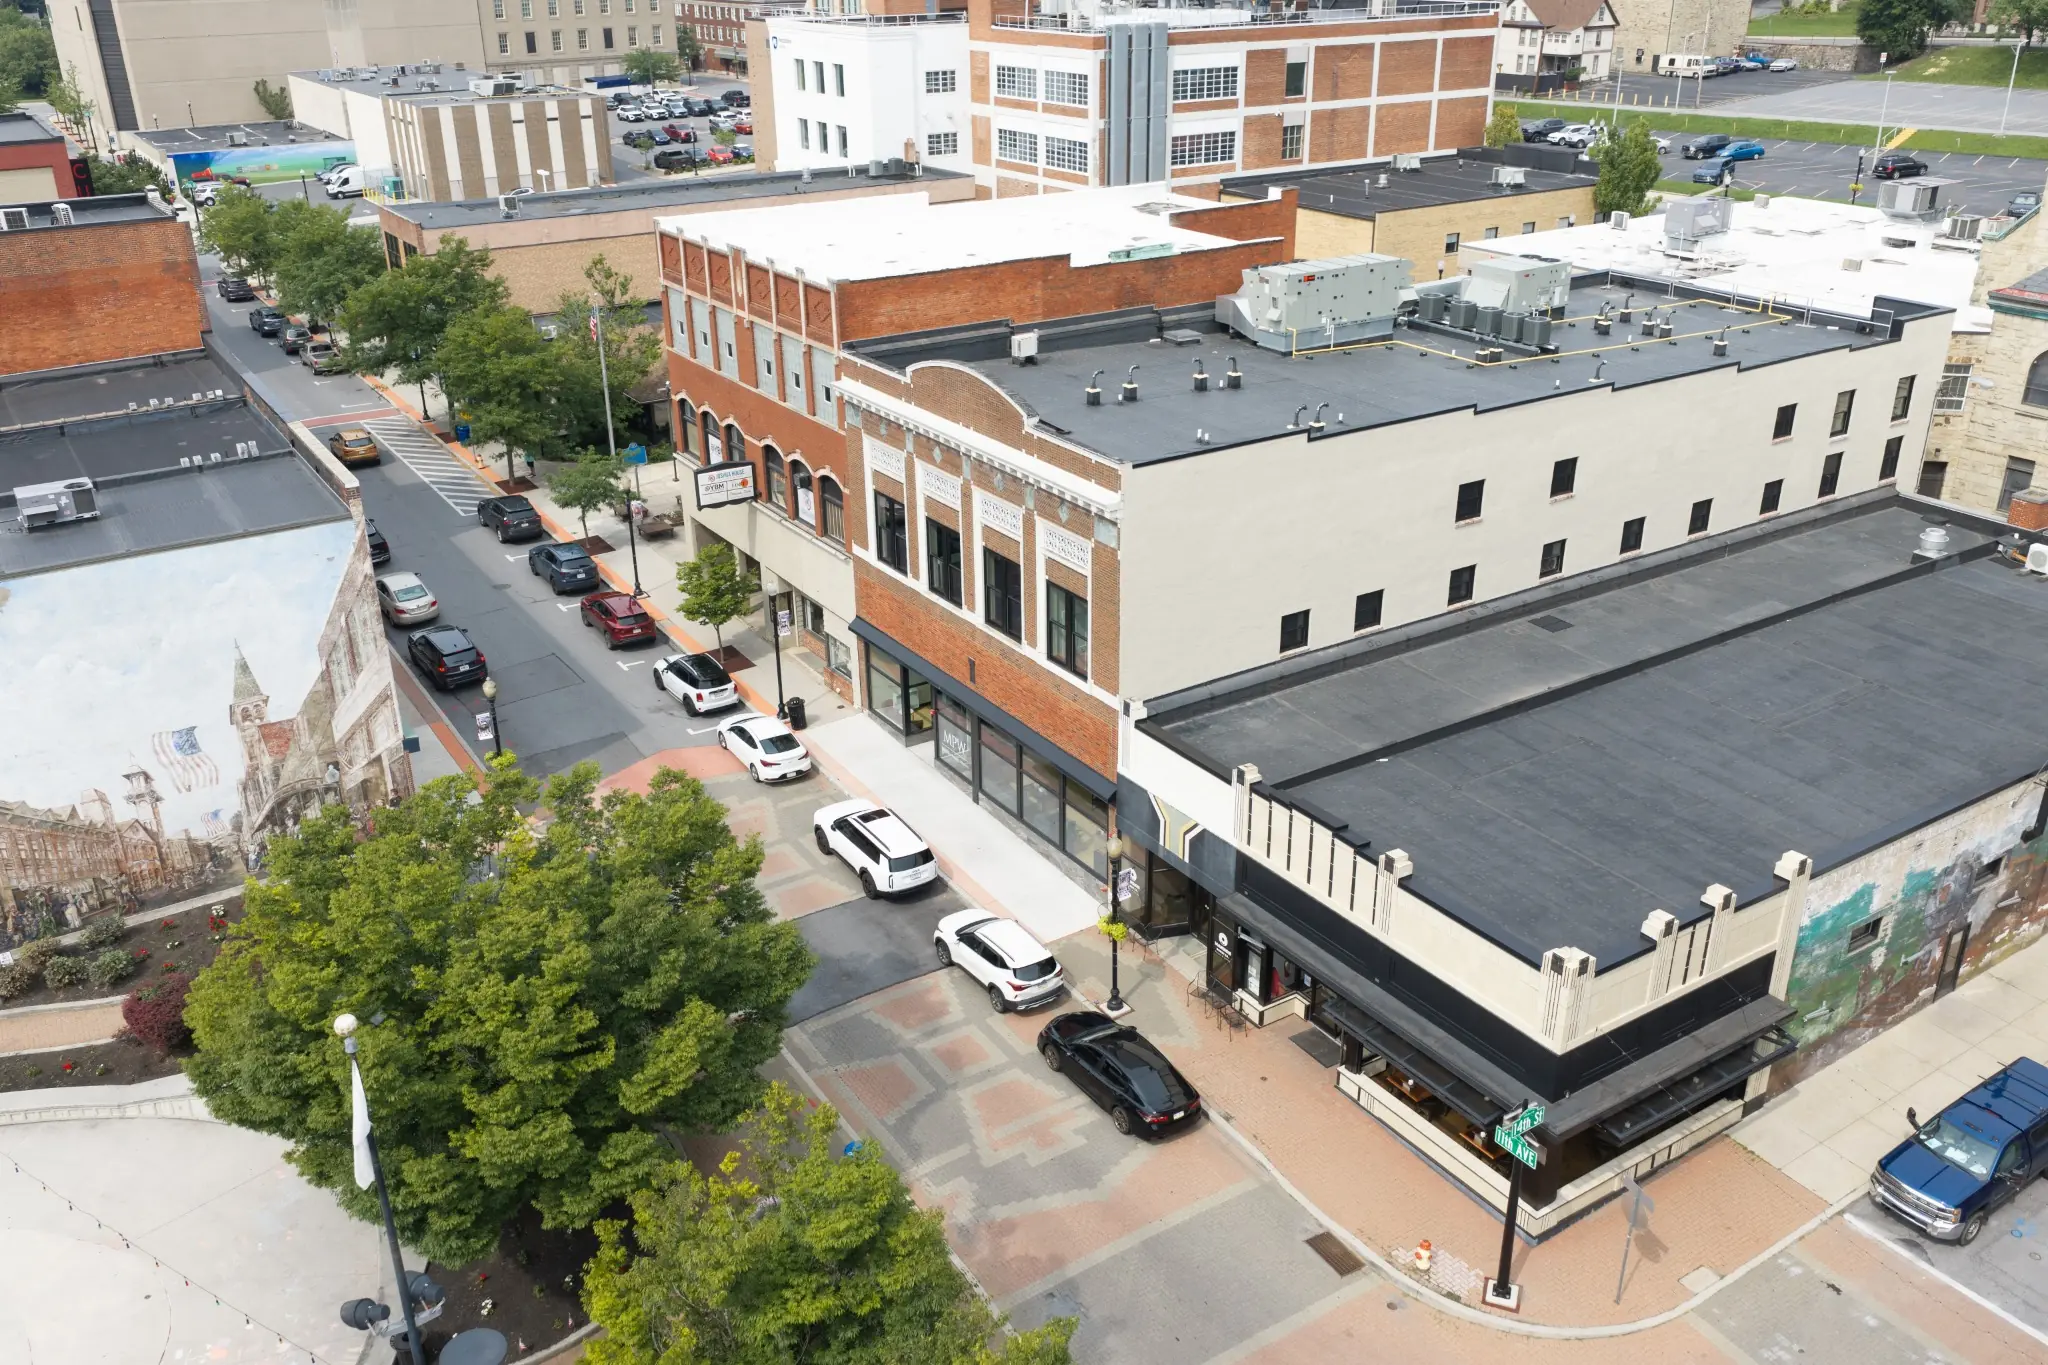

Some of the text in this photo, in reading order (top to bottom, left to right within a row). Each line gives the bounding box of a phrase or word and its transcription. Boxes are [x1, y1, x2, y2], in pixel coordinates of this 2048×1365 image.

[943, 729, 967, 754] MPW
[1513, 1117, 1531, 1136] 14th
[1497, 1129, 1535, 1166] 11th AVE
